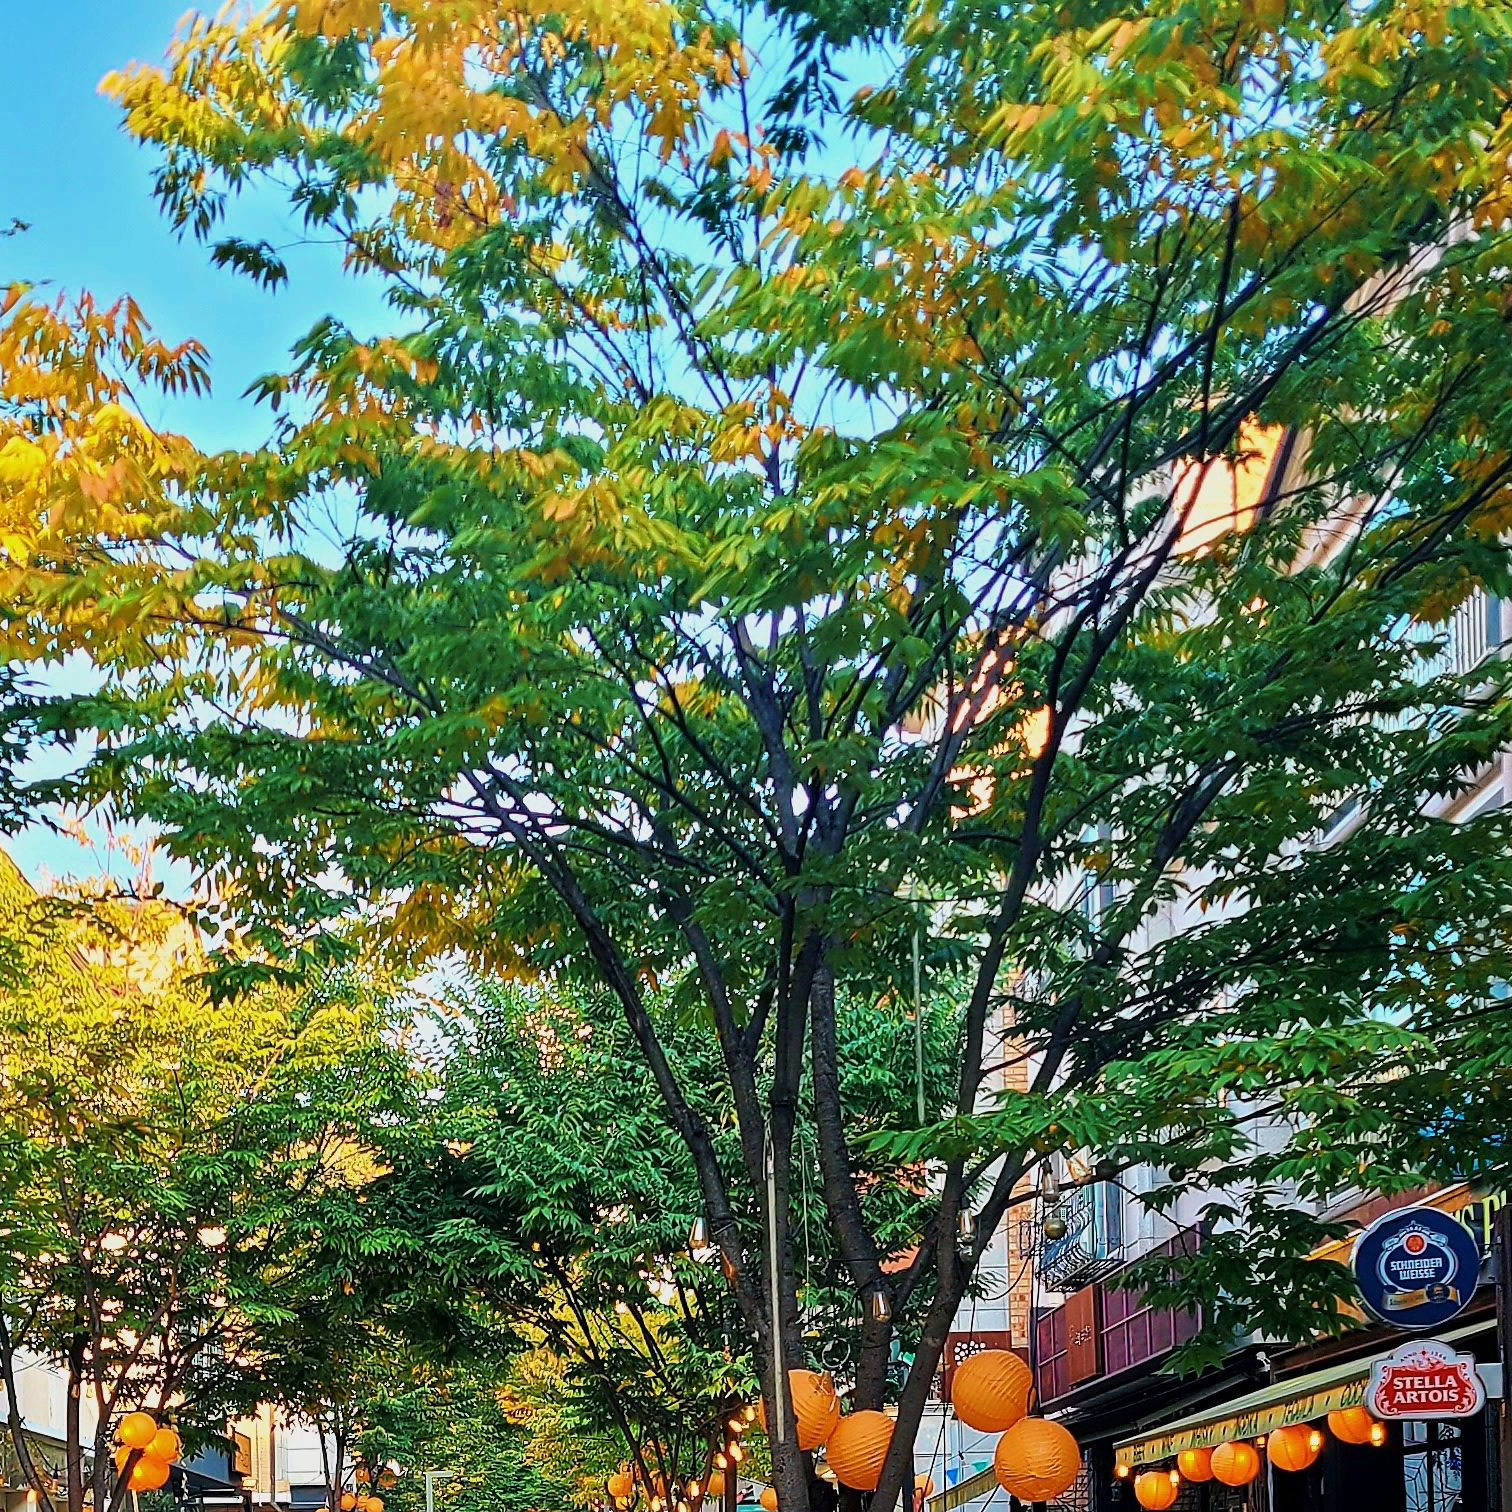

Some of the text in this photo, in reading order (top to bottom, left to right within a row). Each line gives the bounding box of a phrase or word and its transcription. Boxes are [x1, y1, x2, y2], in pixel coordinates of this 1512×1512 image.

[1390, 1258, 1443, 1271] SCHNEIDER
[1399, 1269, 1436, 1280] WEISSE
[1393, 1375, 1458, 1389] STELLA
[1393, 1389, 1459, 1404] ARTOIS
